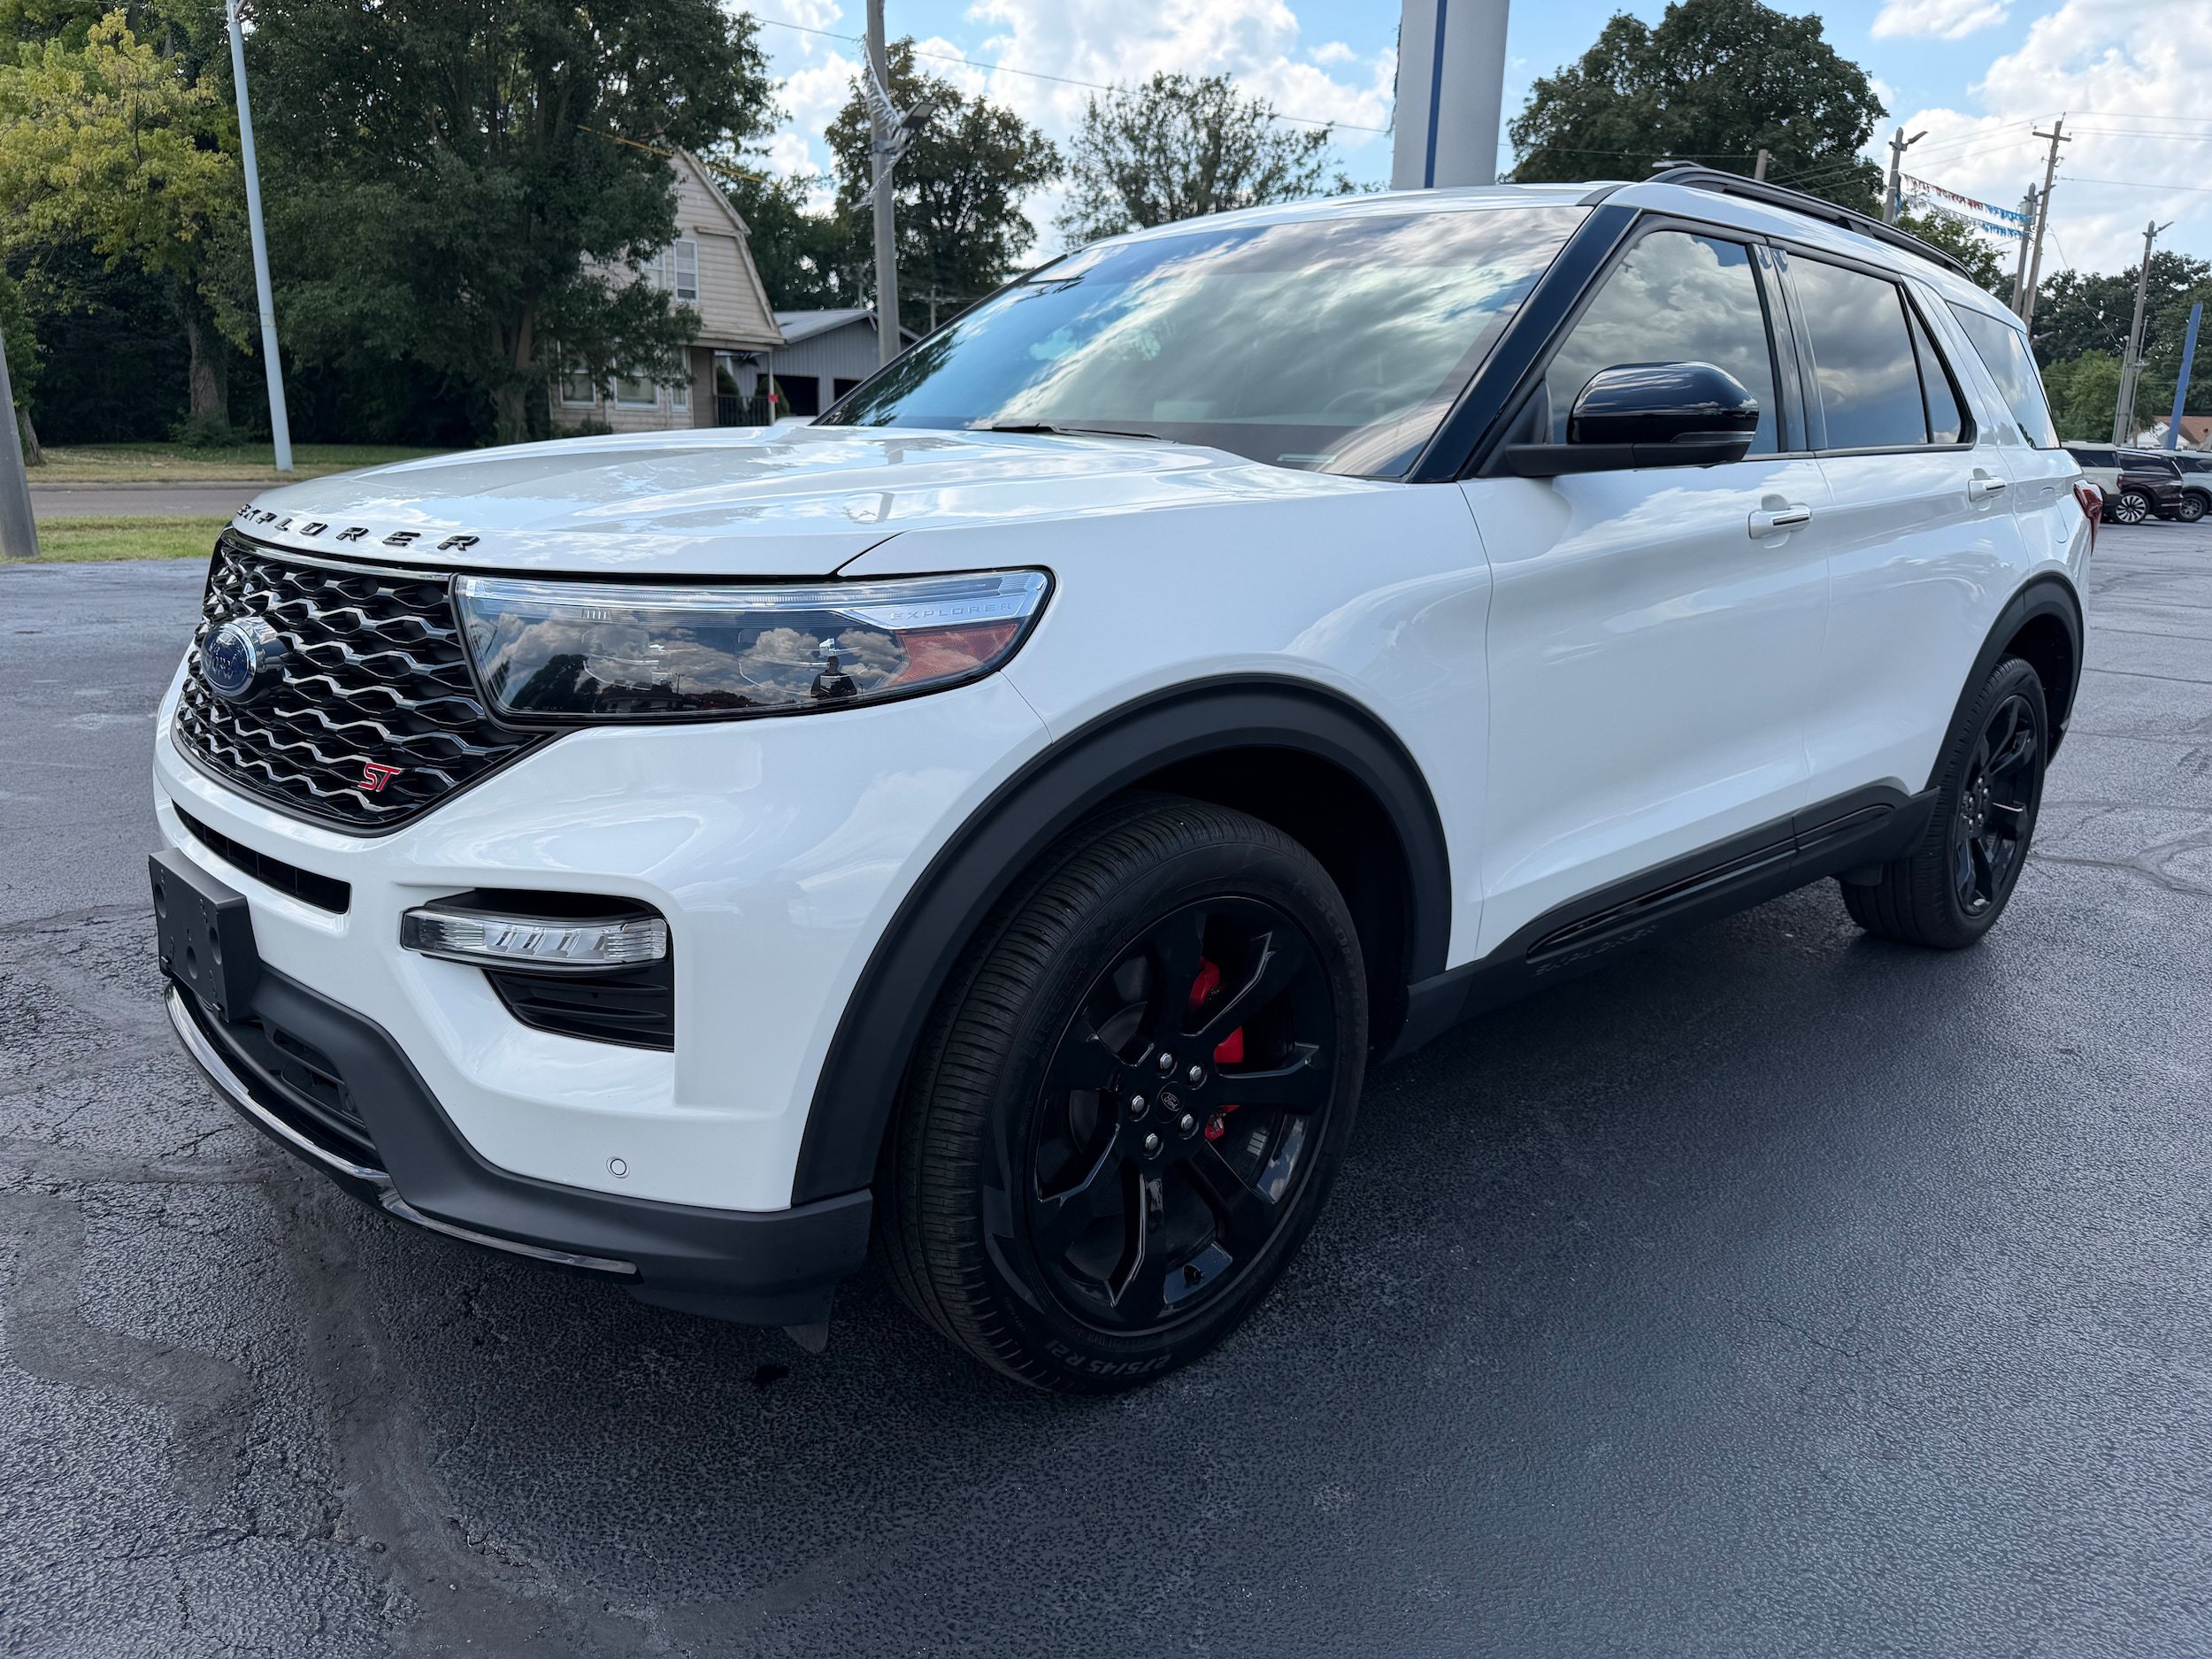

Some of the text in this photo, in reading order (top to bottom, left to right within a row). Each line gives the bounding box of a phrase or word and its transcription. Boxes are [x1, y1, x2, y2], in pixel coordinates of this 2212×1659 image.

[236, 503, 480, 552] EXPLORER
[890, 602, 1012, 621] EXPLORER
[357, 762, 403, 792] ST
